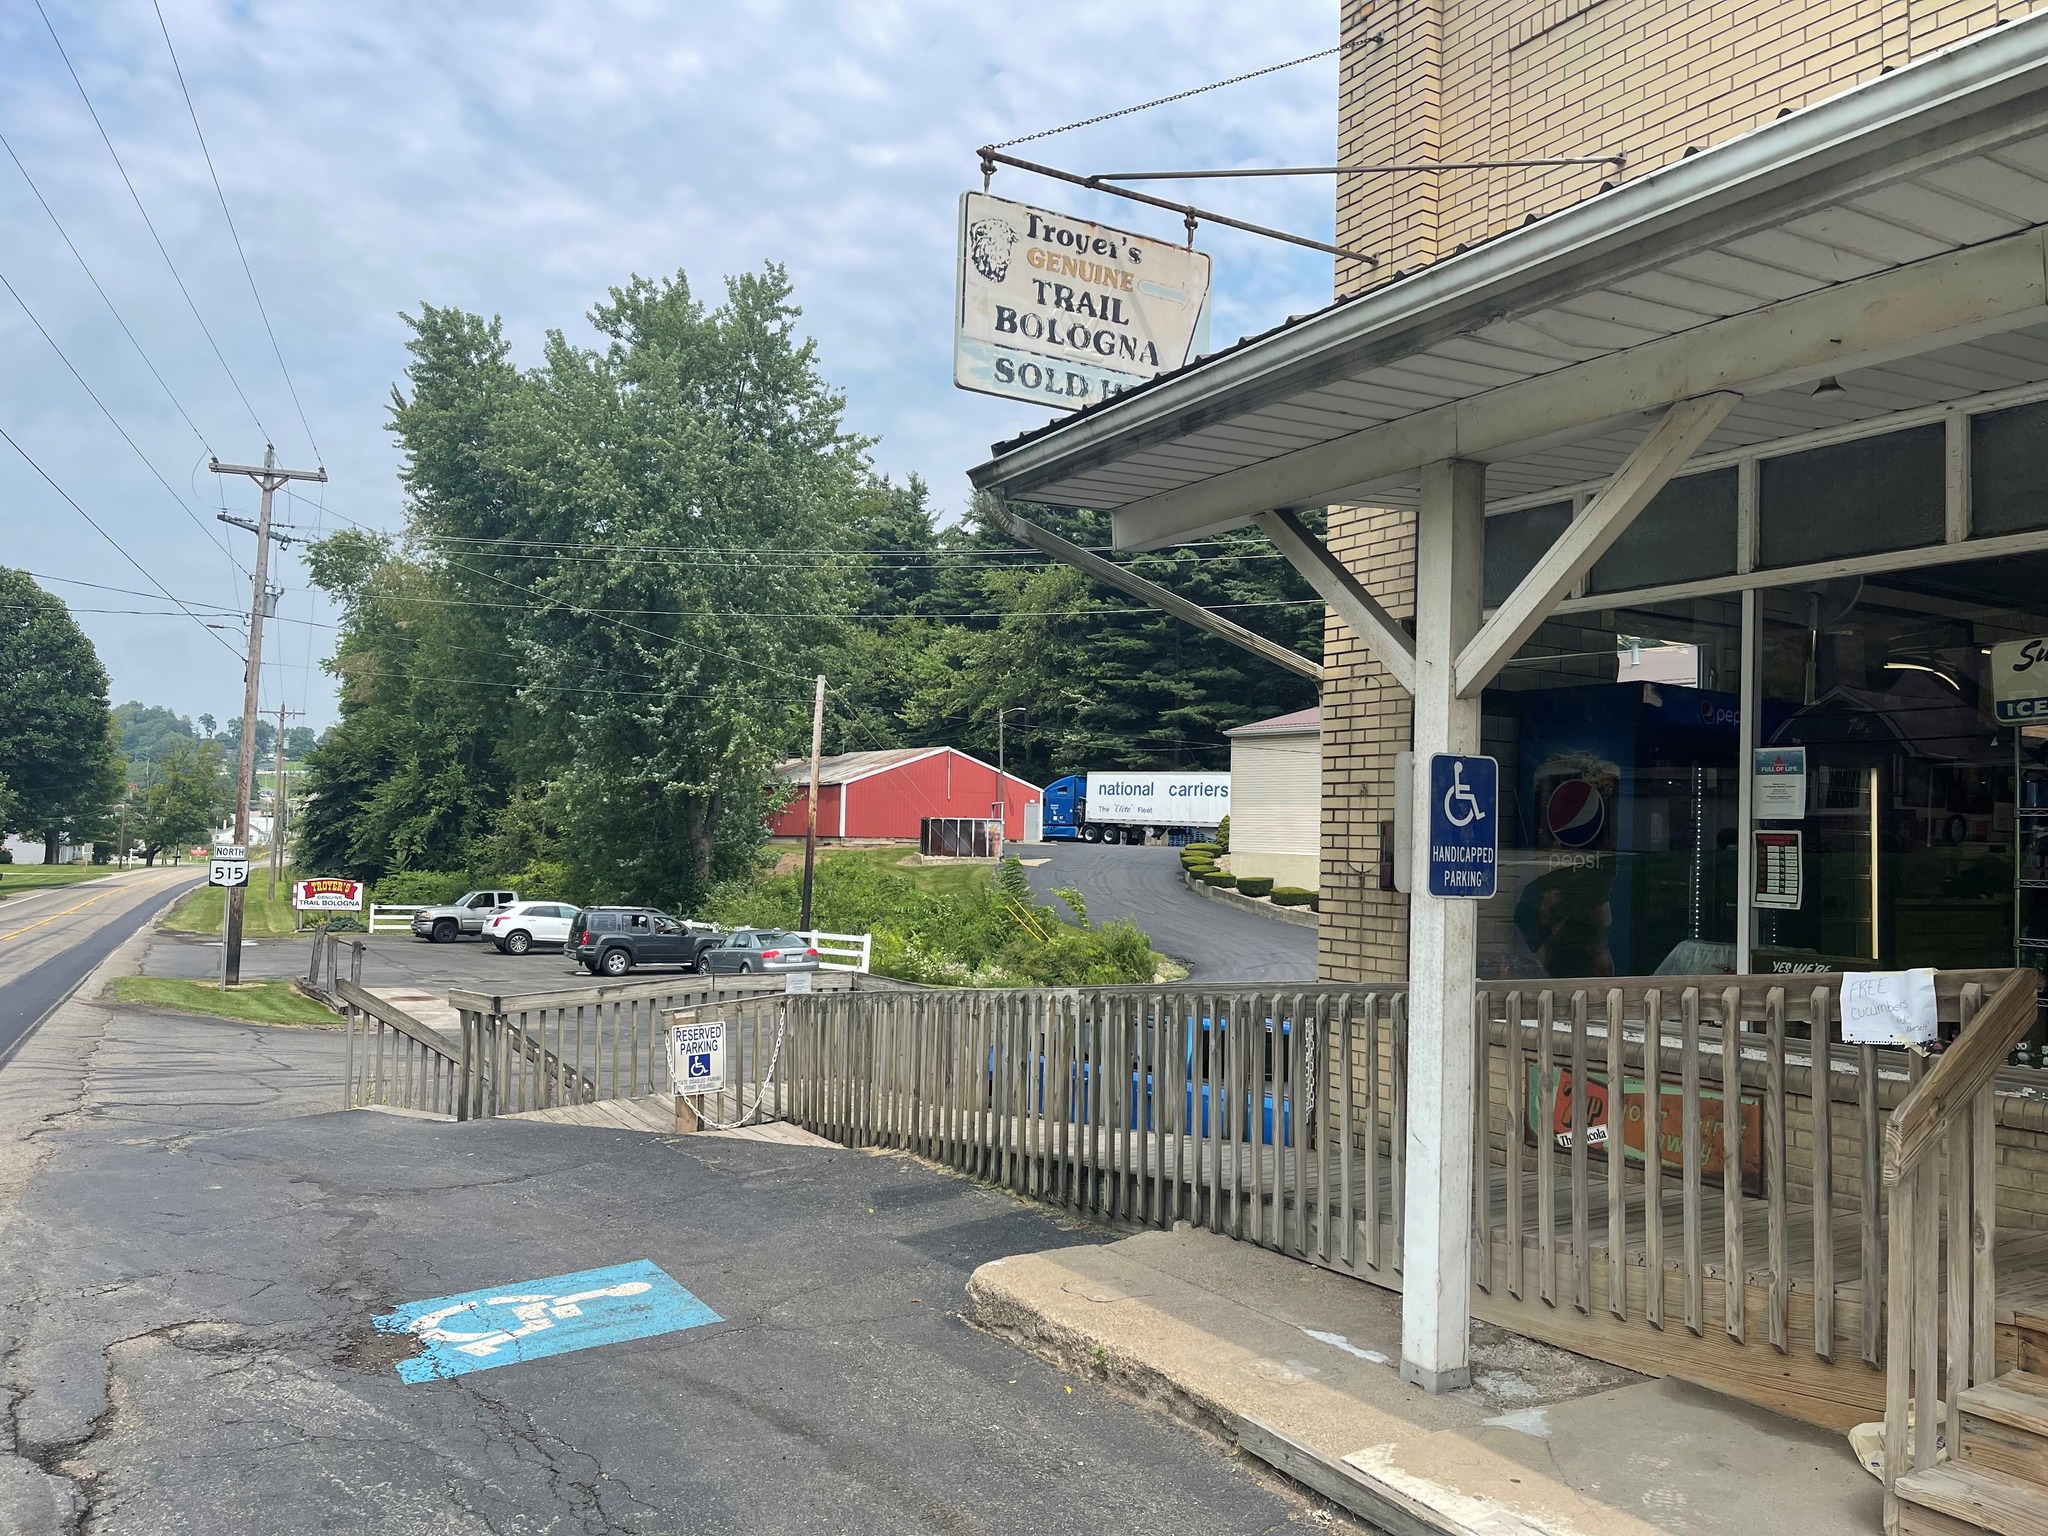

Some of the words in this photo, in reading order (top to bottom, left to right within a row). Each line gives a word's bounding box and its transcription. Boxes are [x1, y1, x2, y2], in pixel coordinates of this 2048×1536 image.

[1024, 212, 1142, 264] Troyer's
[1027, 247, 1135, 293] GENUINE
[1032, 278, 1130, 326] TRAIL
[995, 305, 1159, 367] BOLOGNA
[994, 357, 1089, 399] SOLD
[2012, 639, 2048, 672] Su
[1098, 782, 1154, 796] national
[1168, 782, 1229, 797] carriers
[1099, 805, 1110, 813] The
[1137, 806, 1153, 814] Fleet
[216, 847, 245, 857] NORTH
[1432, 845, 1494, 864] HANDICAPPED
[1548, 851, 1600, 873] pepsi
[215, 867, 244, 880] 515
[1444, 870, 1482, 887] PARKING
[311, 880, 351, 893] TROYER'S
[1772, 961, 1792, 974] YES
[1849, 977, 1889, 1002] FREE
[675, 1026, 722, 1042] RESERVED
[680, 1040, 719, 1055] PARKING
